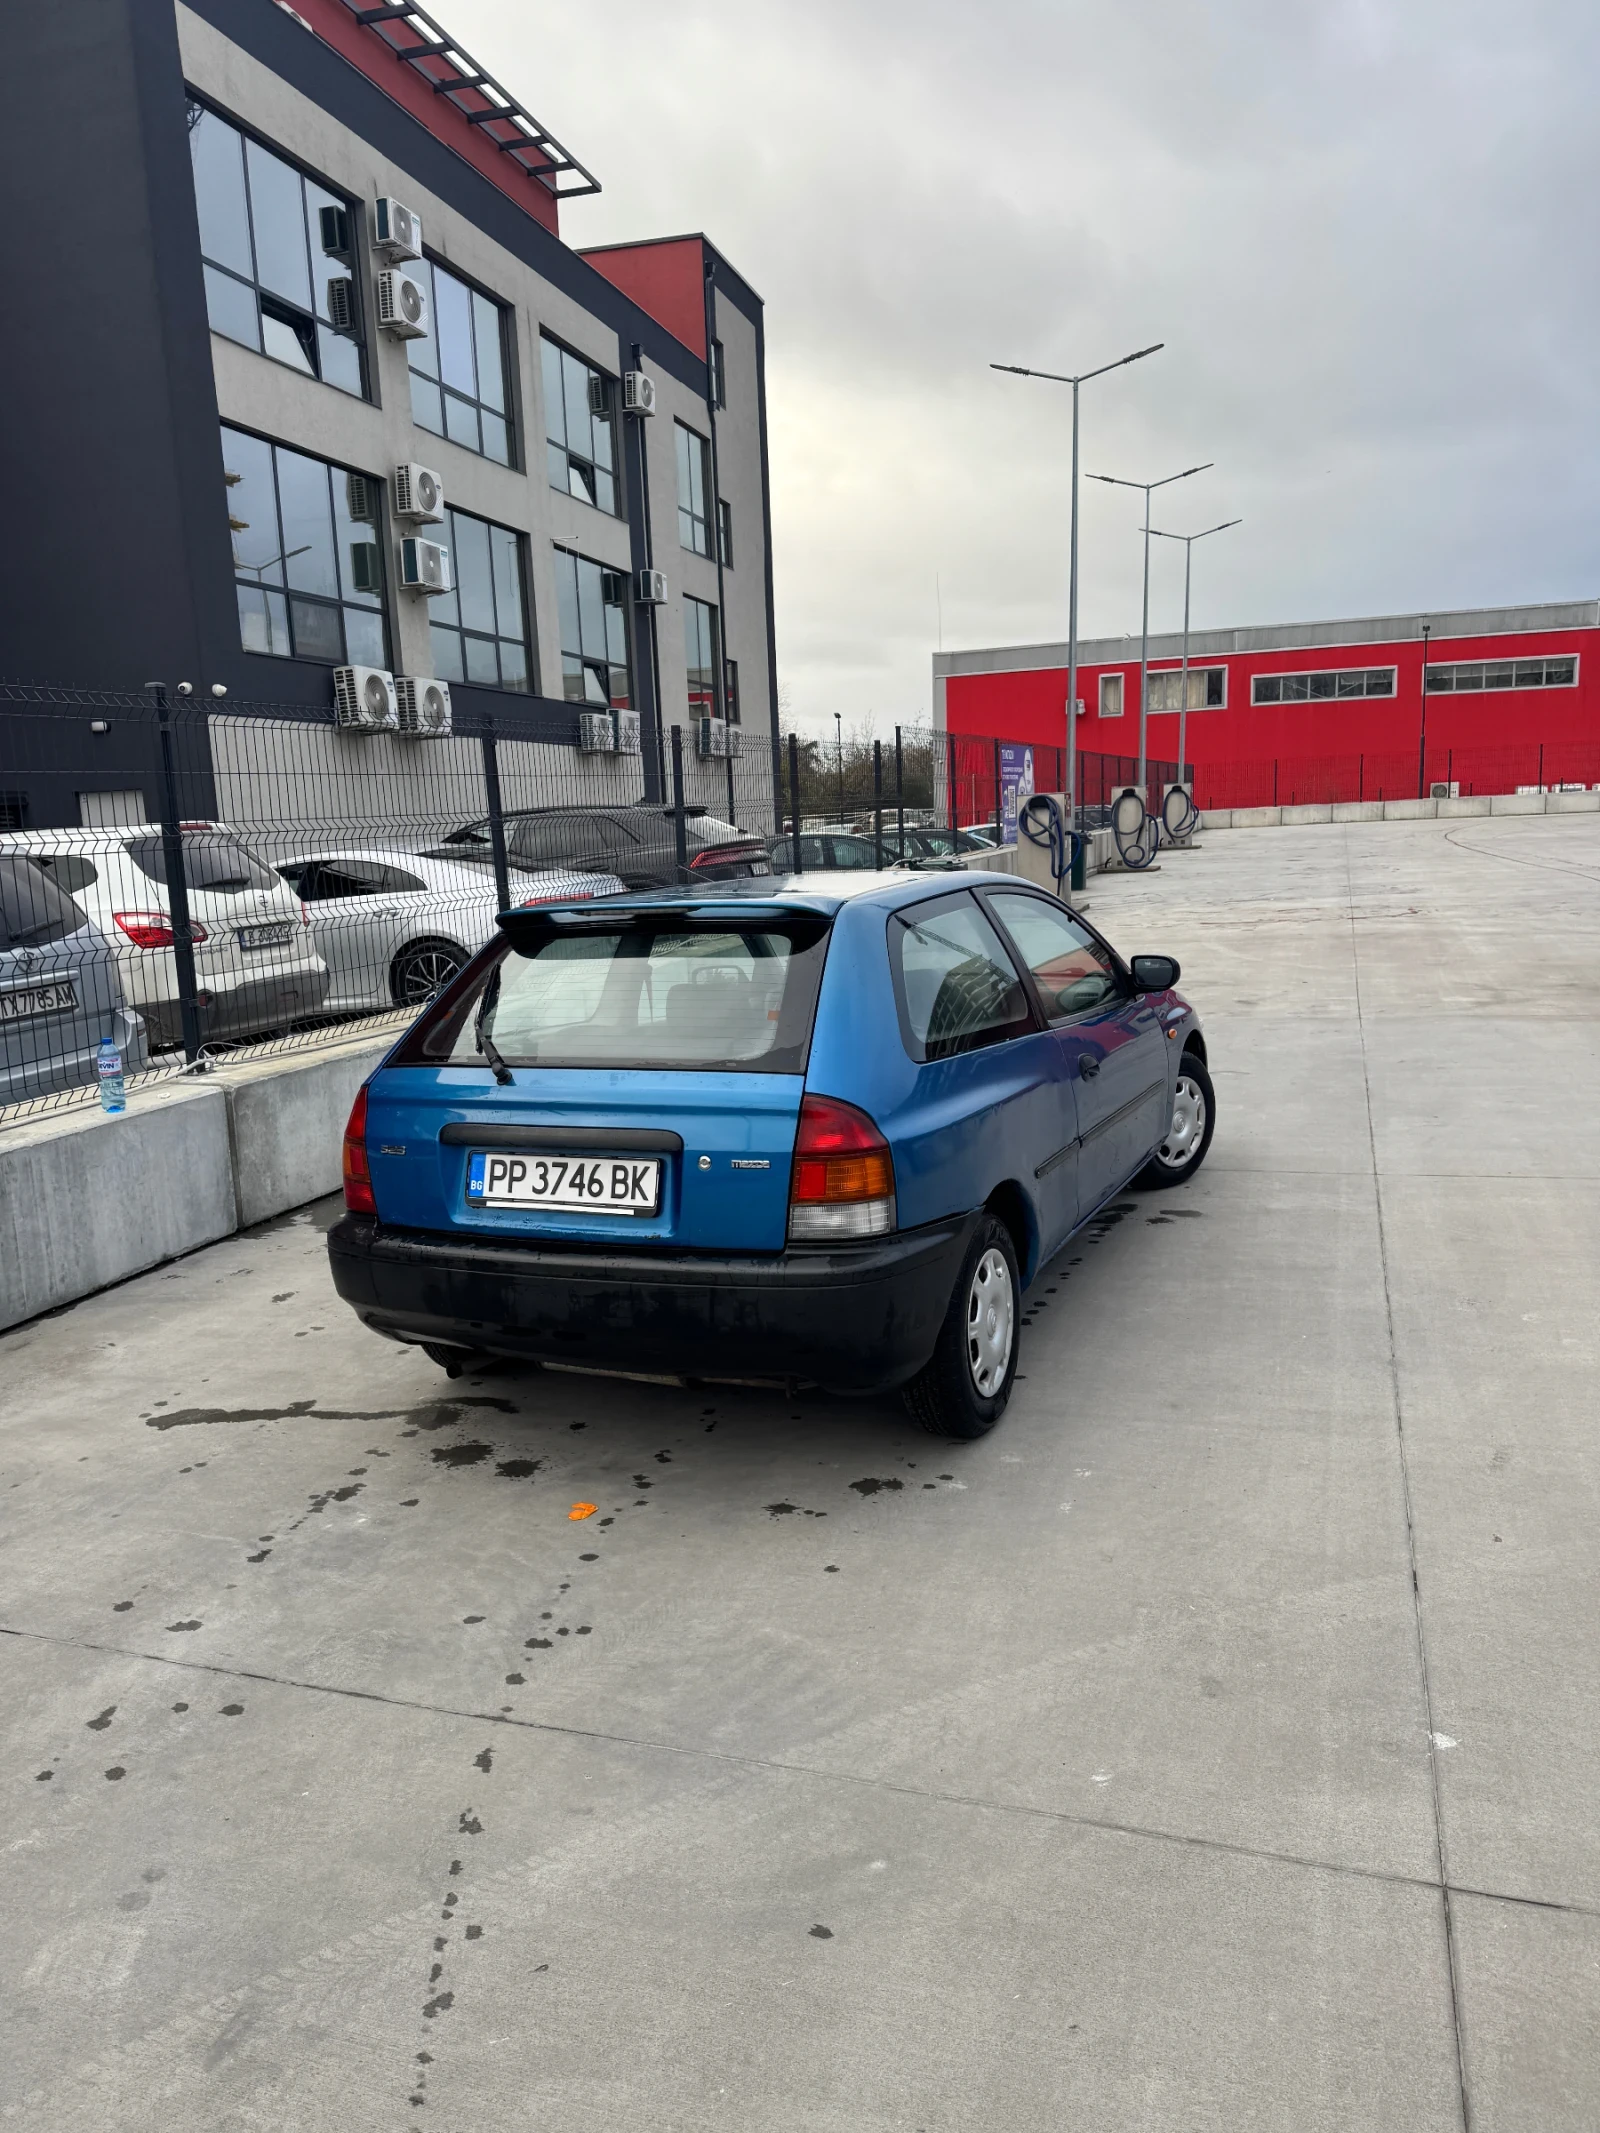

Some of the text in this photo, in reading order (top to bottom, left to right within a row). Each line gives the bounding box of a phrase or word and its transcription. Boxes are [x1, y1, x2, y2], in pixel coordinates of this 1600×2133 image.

[19, 989, 54, 1013] 7785
[55, 984, 75, 1006] AM
[470, 1180, 483, 1191] BG
[488, 1159, 651, 1202] PP 3746 BK
